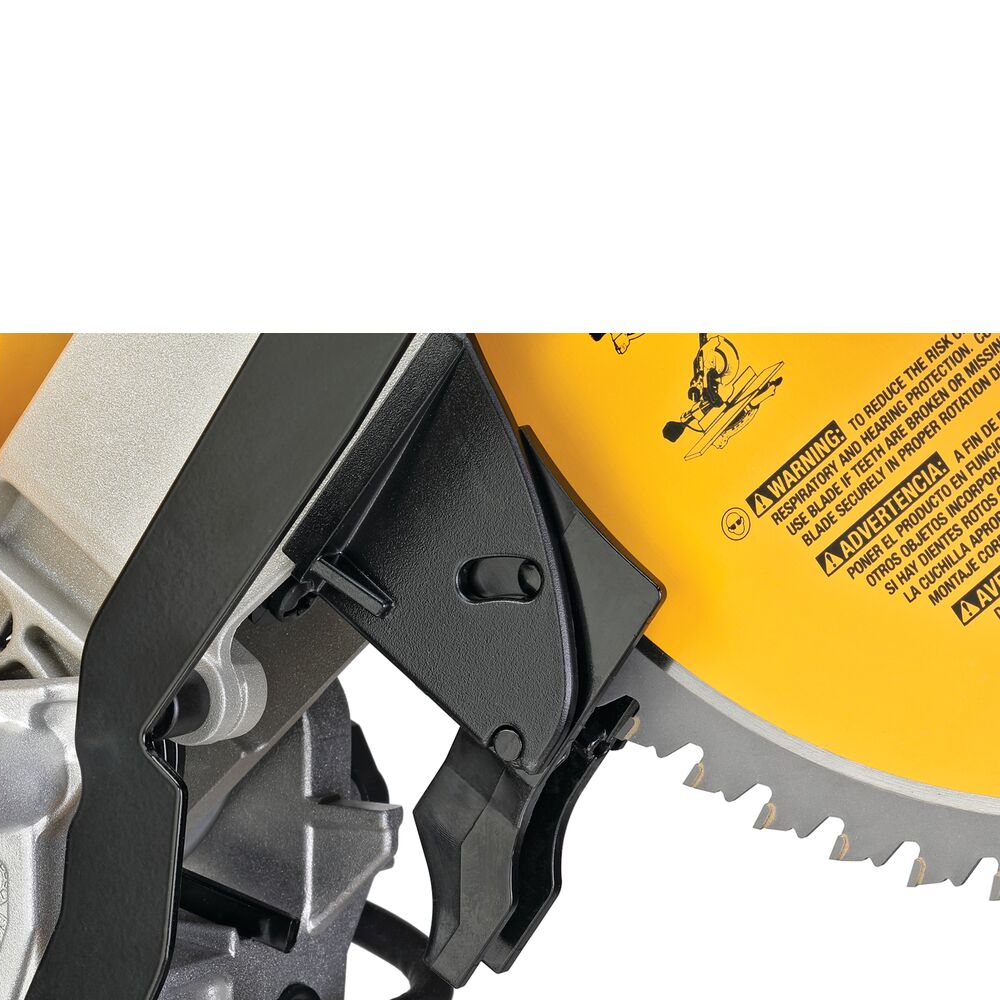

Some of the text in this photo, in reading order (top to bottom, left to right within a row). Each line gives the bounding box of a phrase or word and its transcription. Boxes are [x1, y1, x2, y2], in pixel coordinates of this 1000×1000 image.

[848, 334, 954, 431] TO REDUCE THE RISK
[766, 427, 846, 499] WARNING:
[771, 460, 839, 526] RESPIRATORY
[838, 440, 862, 467] AND
[860, 400, 908, 446] HEARING
[905, 343, 974, 406] PROTECTION.
[786, 511, 810, 536] USE
[806, 482, 843, 518] BLADE
[840, 472, 852, 488] IF
[850, 444, 887, 478] TEETH
[884, 424, 908, 450] ARE
[905, 387, 950, 430] BROKEN
[947, 372, 967, 392] OR
[801, 511, 838, 547] BLADE
[834, 466, 886, 517] SECURELY
[885, 455, 900, 473] IN
[897, 419, 941, 462] PROPER
[938, 375, 991, 426] ROTATION
[953, 417, 1000, 464] A FIN DE
[838, 460, 948, 560] ADVERTENCIA:
[846, 544, 884, 580] PONER
[881, 533, 898, 550] EL
[895, 484, 952, 538] PRODUCTO
[949, 469, 969, 490] EN
[865, 552, 902, 587] OTROS
[899, 512, 948, 558] OBJETOS
[884, 493, 999, 595] SI HAY DIENTES ROTOS
[903, 585, 921, 604] LA
[918, 542, 971, 590] CUCHILLA
[928, 557, 980, 606] MONTAJE
